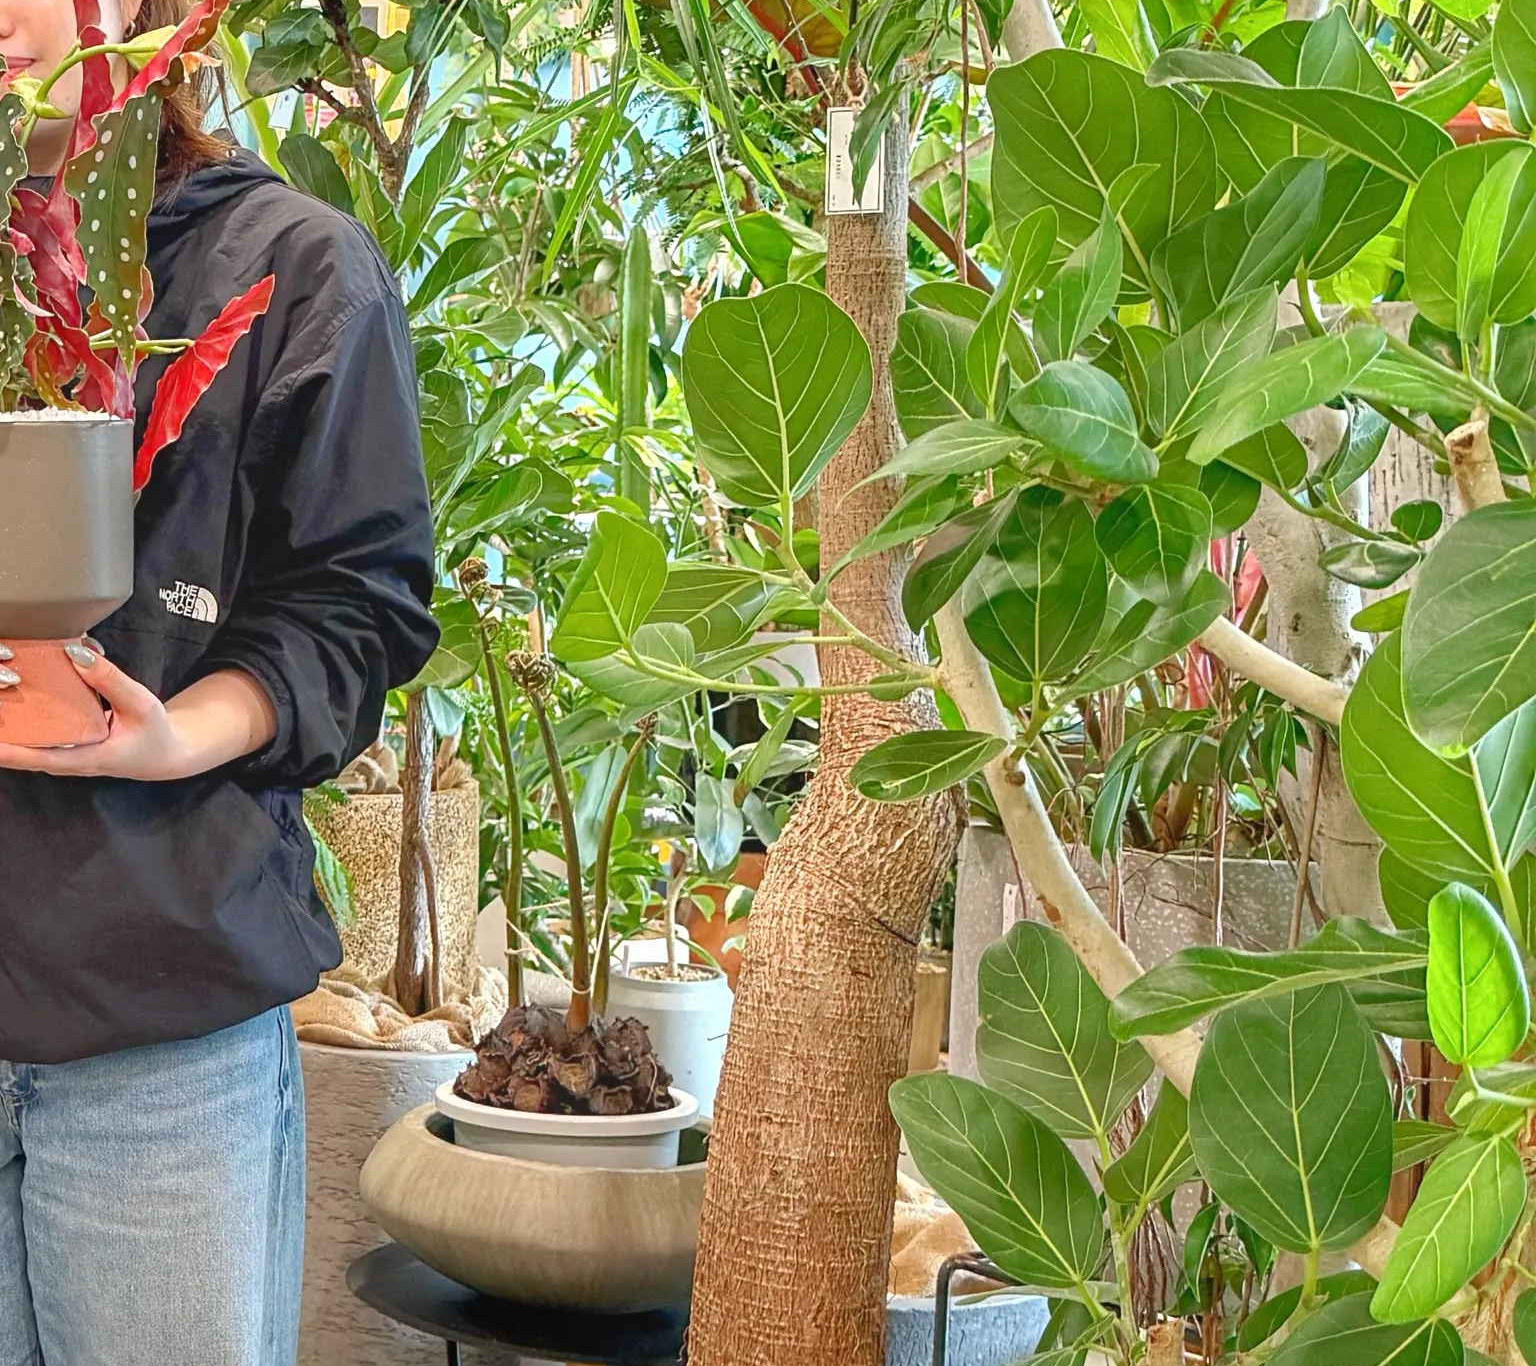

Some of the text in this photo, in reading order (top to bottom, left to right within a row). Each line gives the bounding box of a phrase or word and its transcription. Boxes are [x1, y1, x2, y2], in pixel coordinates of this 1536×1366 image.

[174, 580, 199, 597] THE
[158, 587, 197, 610] NORTH
[166, 601, 193, 617] FACE
